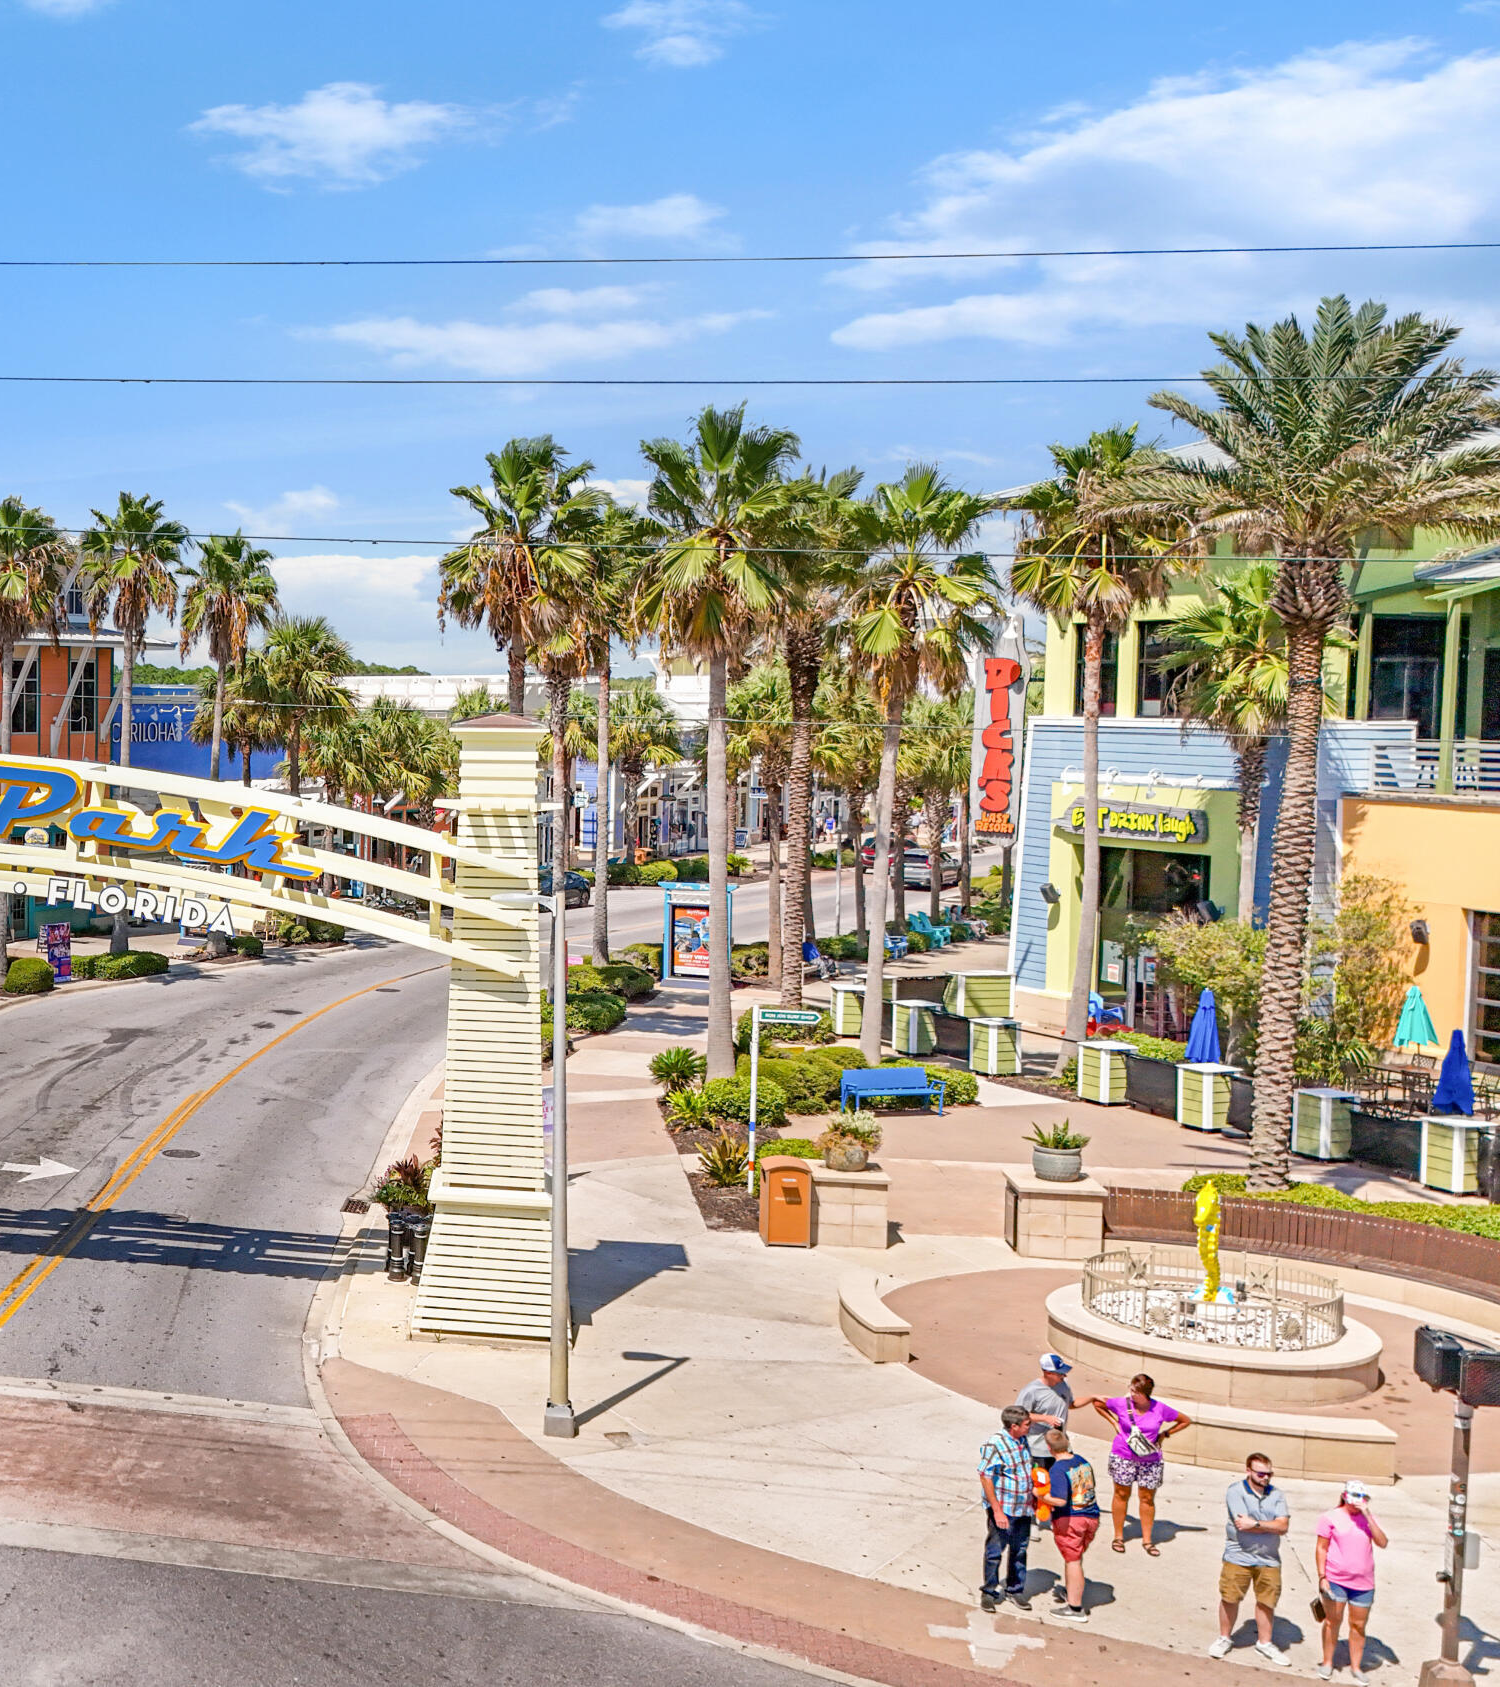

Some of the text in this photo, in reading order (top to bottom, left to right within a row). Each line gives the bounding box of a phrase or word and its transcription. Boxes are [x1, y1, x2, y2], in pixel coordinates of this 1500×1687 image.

[112, 722, 177, 742] CRILOHA
[977, 657, 1021, 813] DICK'S
[975, 820, 1015, 834] RESORT
[980, 812, 1010, 824] LAST
[1071, 806, 1197, 843] ET DRINK laugh
[46, 876, 236, 938] FLORIDA
